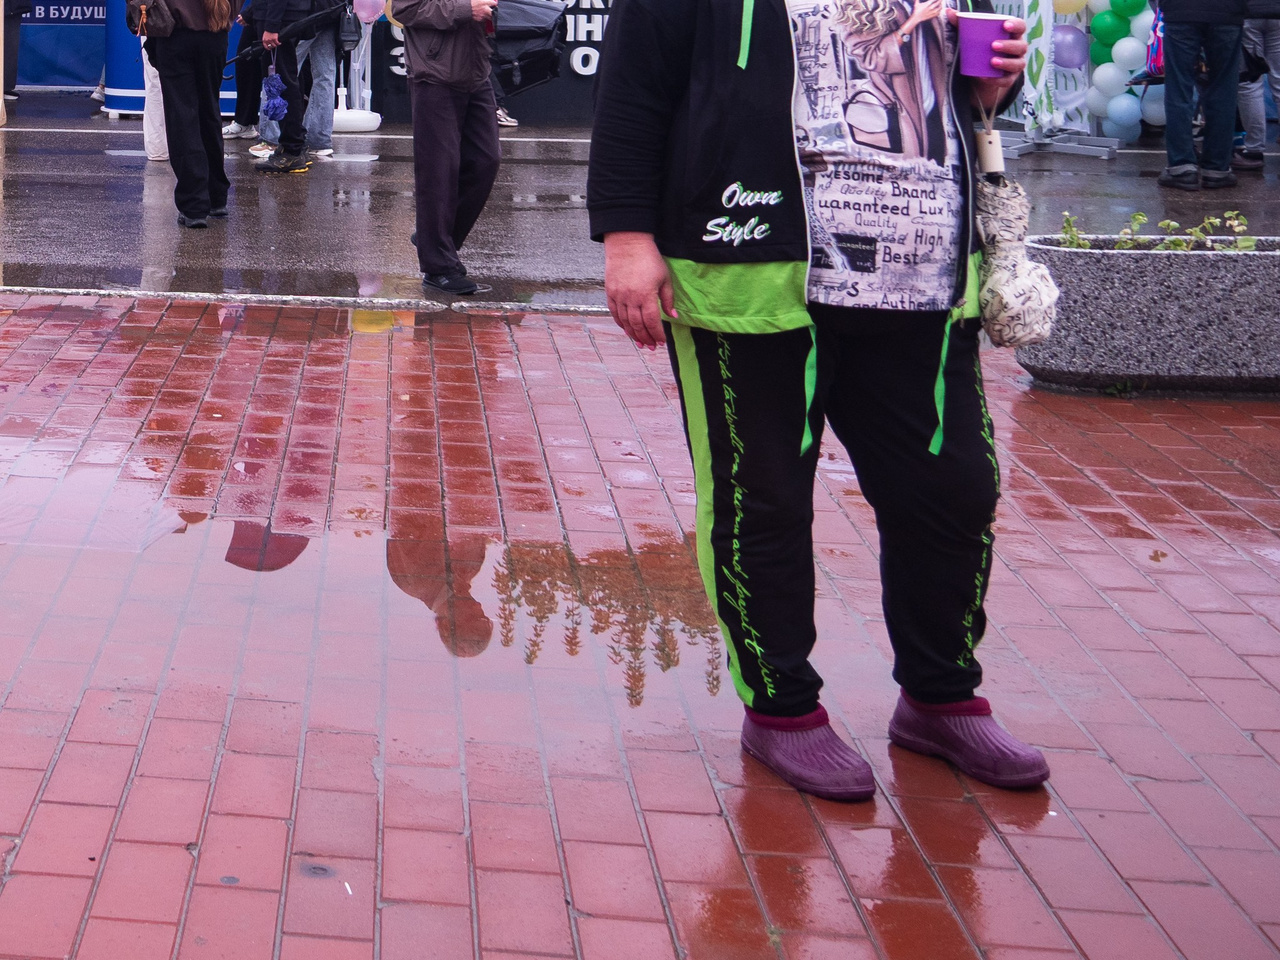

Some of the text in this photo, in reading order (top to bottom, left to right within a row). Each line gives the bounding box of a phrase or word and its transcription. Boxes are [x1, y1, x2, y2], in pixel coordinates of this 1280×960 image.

[722, 181, 783, 208] Own
[702, 216, 771, 247] Style
[914, 228, 943, 253] High
[882, 245, 919, 265] Best
